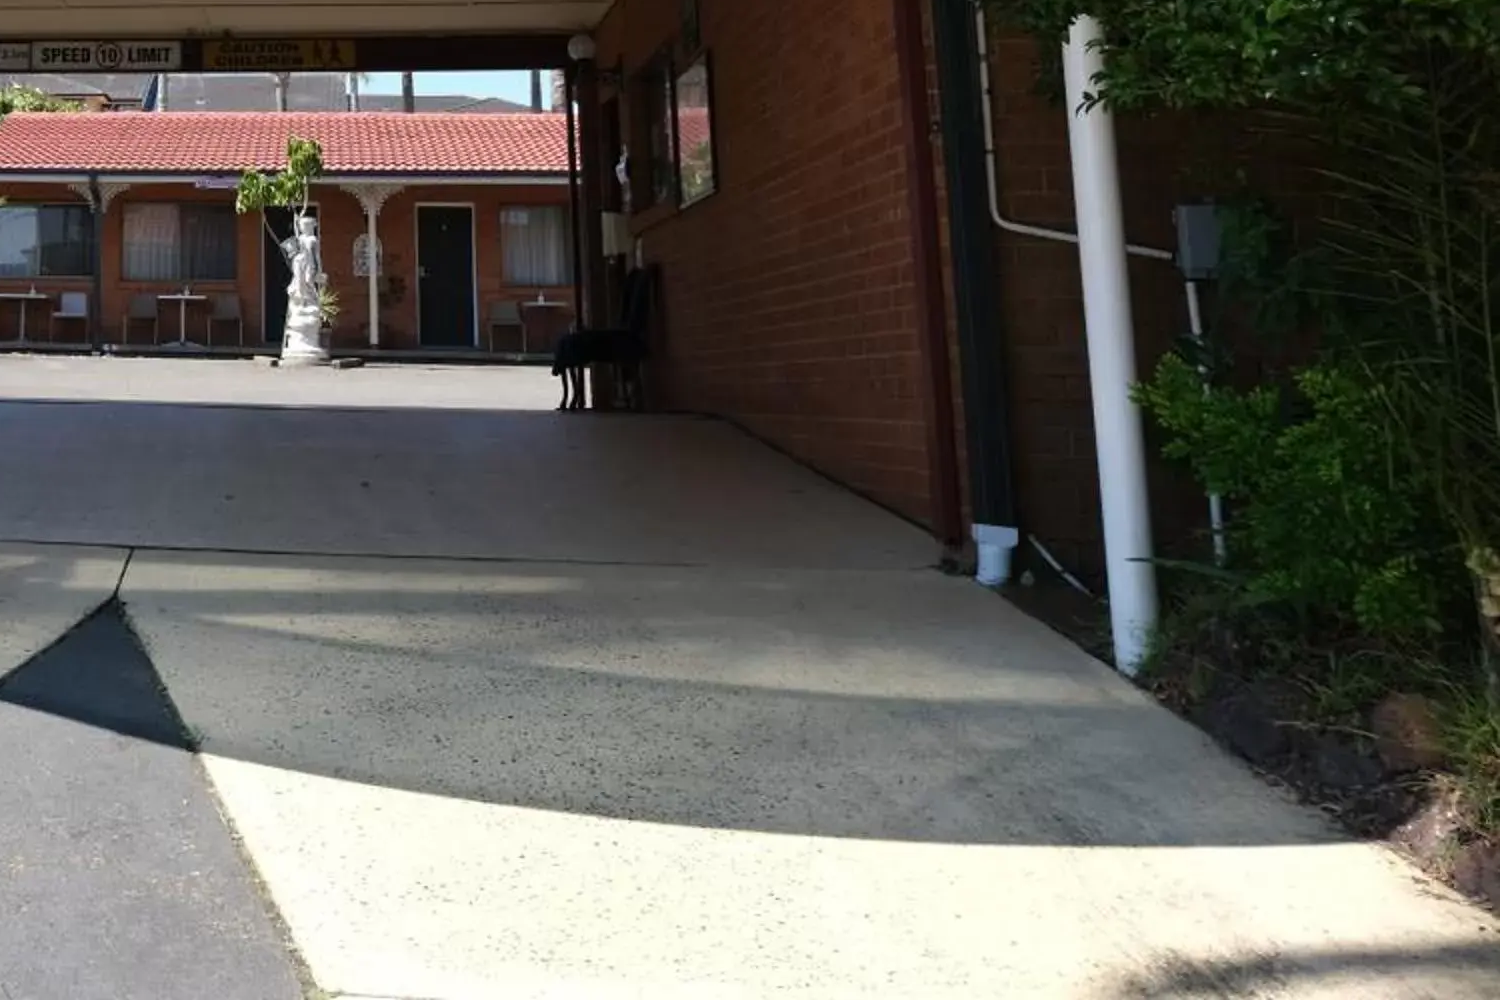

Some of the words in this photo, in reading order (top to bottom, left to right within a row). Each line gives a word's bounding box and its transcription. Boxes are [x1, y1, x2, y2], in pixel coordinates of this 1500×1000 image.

[40, 47, 91, 63] SPEED
[100, 47, 118, 63] 10
[127, 47, 172, 63] LIMIT
